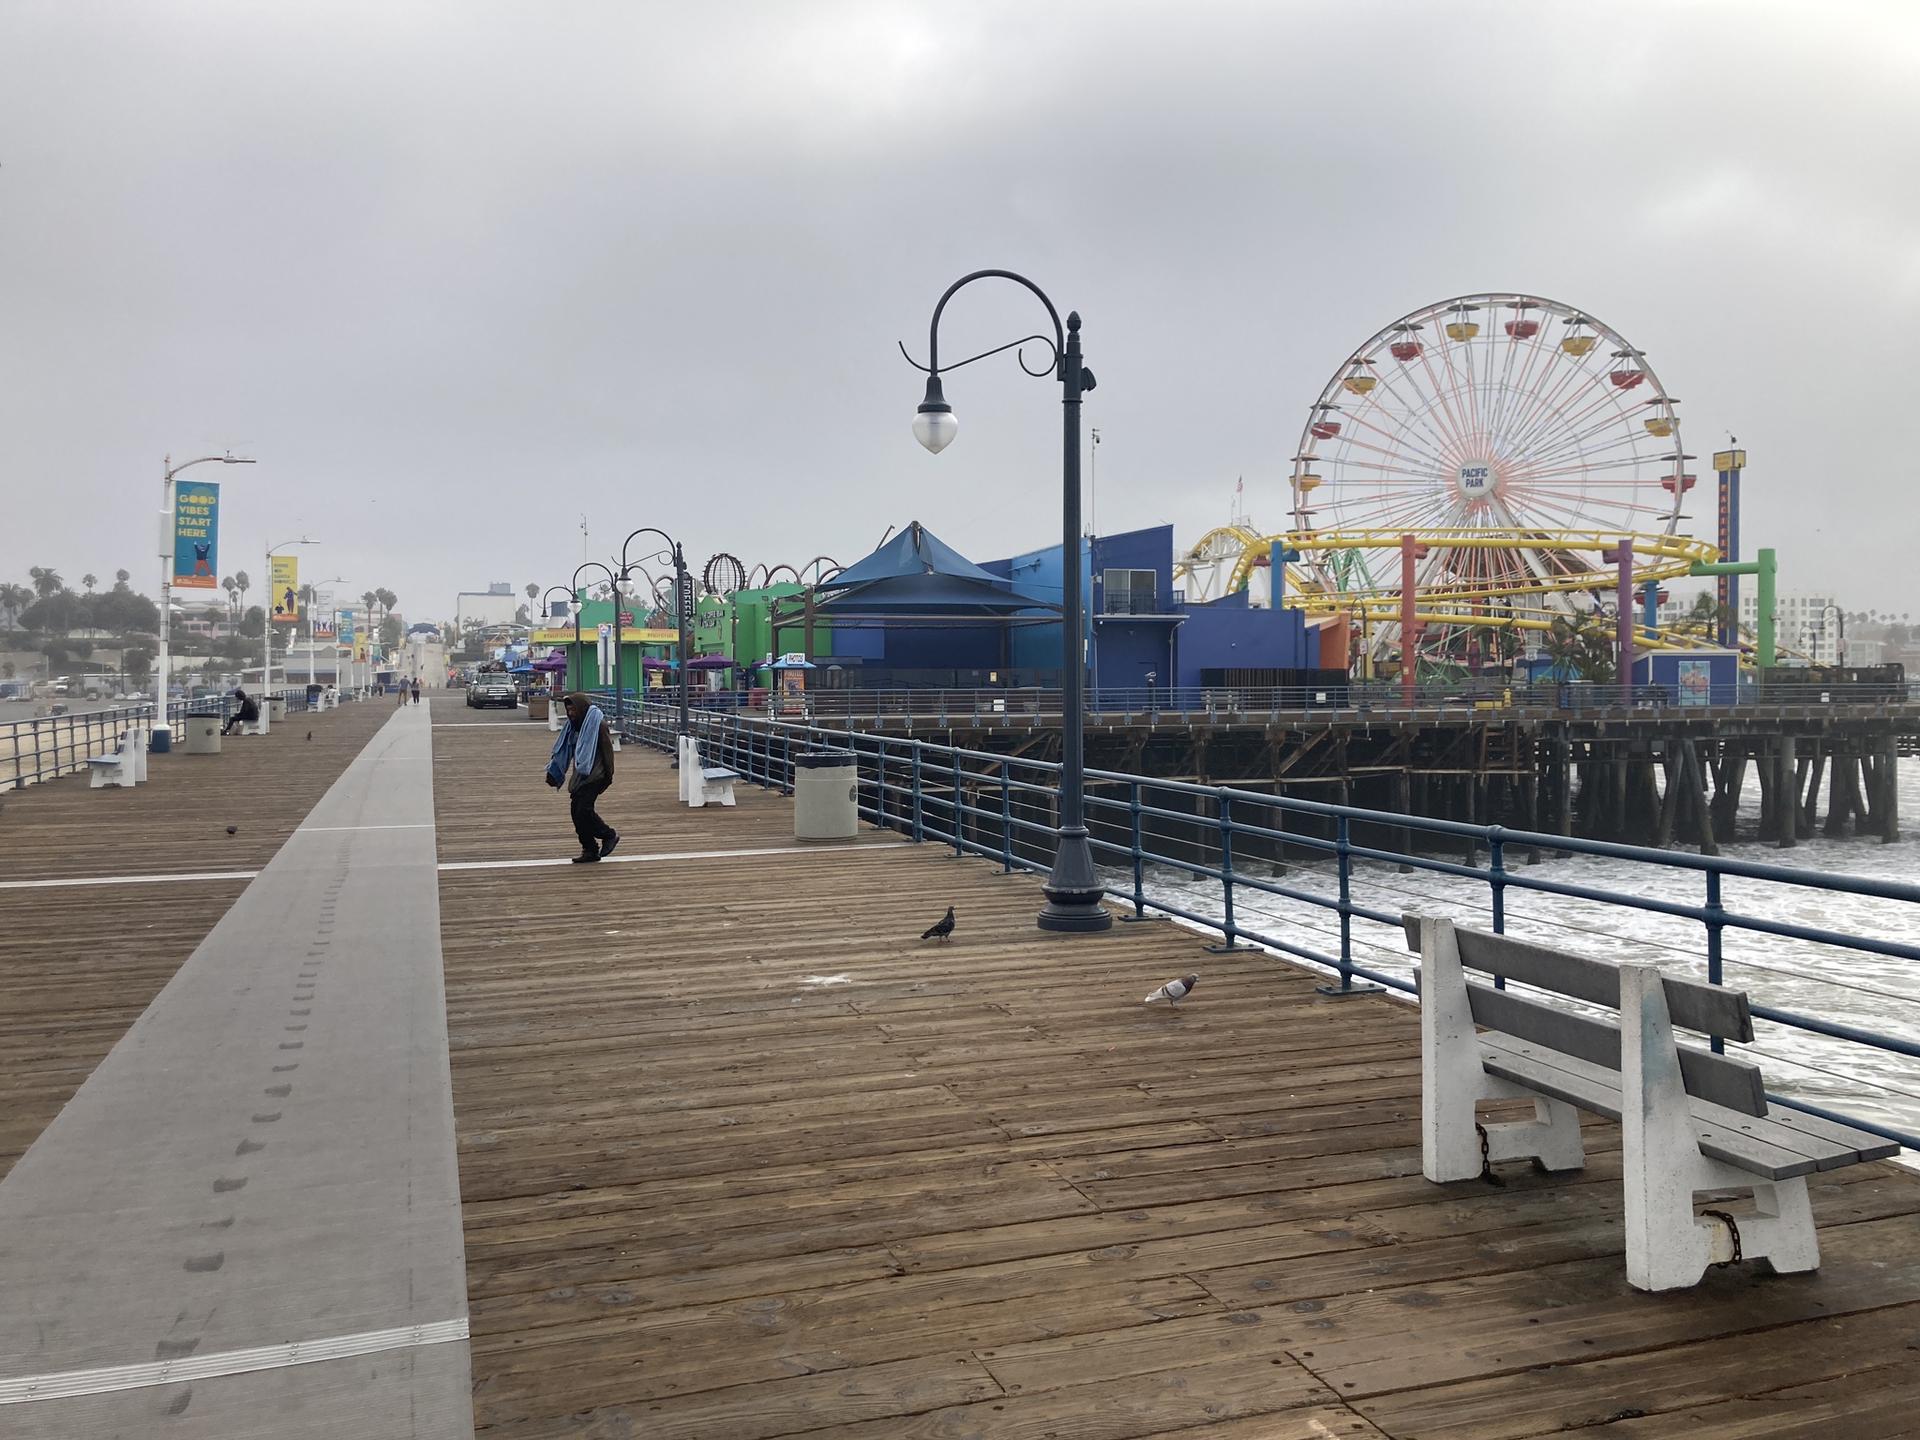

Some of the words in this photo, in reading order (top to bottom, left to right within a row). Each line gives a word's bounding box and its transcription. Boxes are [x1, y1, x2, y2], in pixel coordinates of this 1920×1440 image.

[1462, 468, 1488, 478] PACIFIC
[1466, 478, 1484, 488] PARK
[180, 495, 216, 505] GOOD
[179, 505, 210, 515] VIBES
[178, 517, 212, 526] START
[178, 528, 208, 537] HERE
